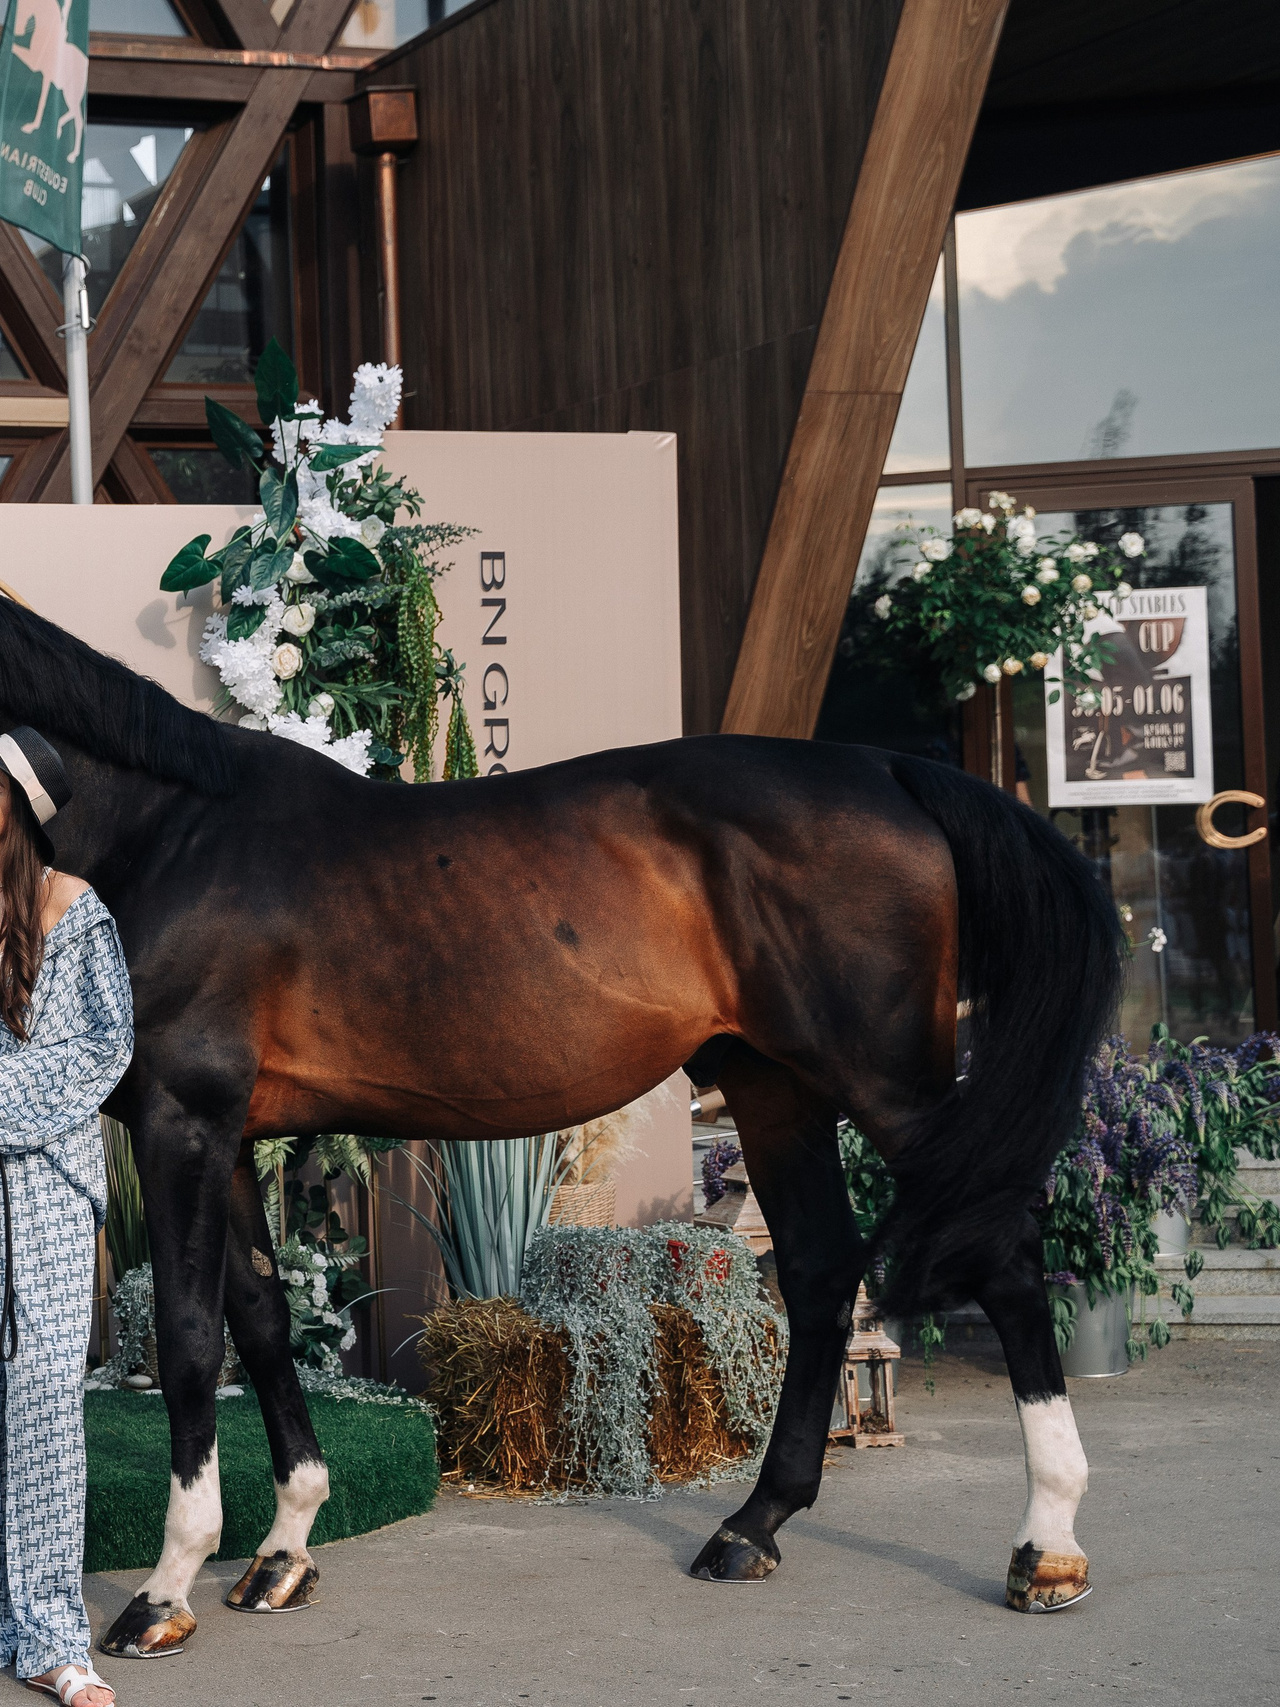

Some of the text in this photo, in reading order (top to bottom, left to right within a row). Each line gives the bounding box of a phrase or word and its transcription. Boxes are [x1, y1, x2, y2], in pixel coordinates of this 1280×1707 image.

[480, 551, 507, 645] BN
[1129, 592, 1187, 615] STABLES
[1138, 621, 1175, 653] CUP
